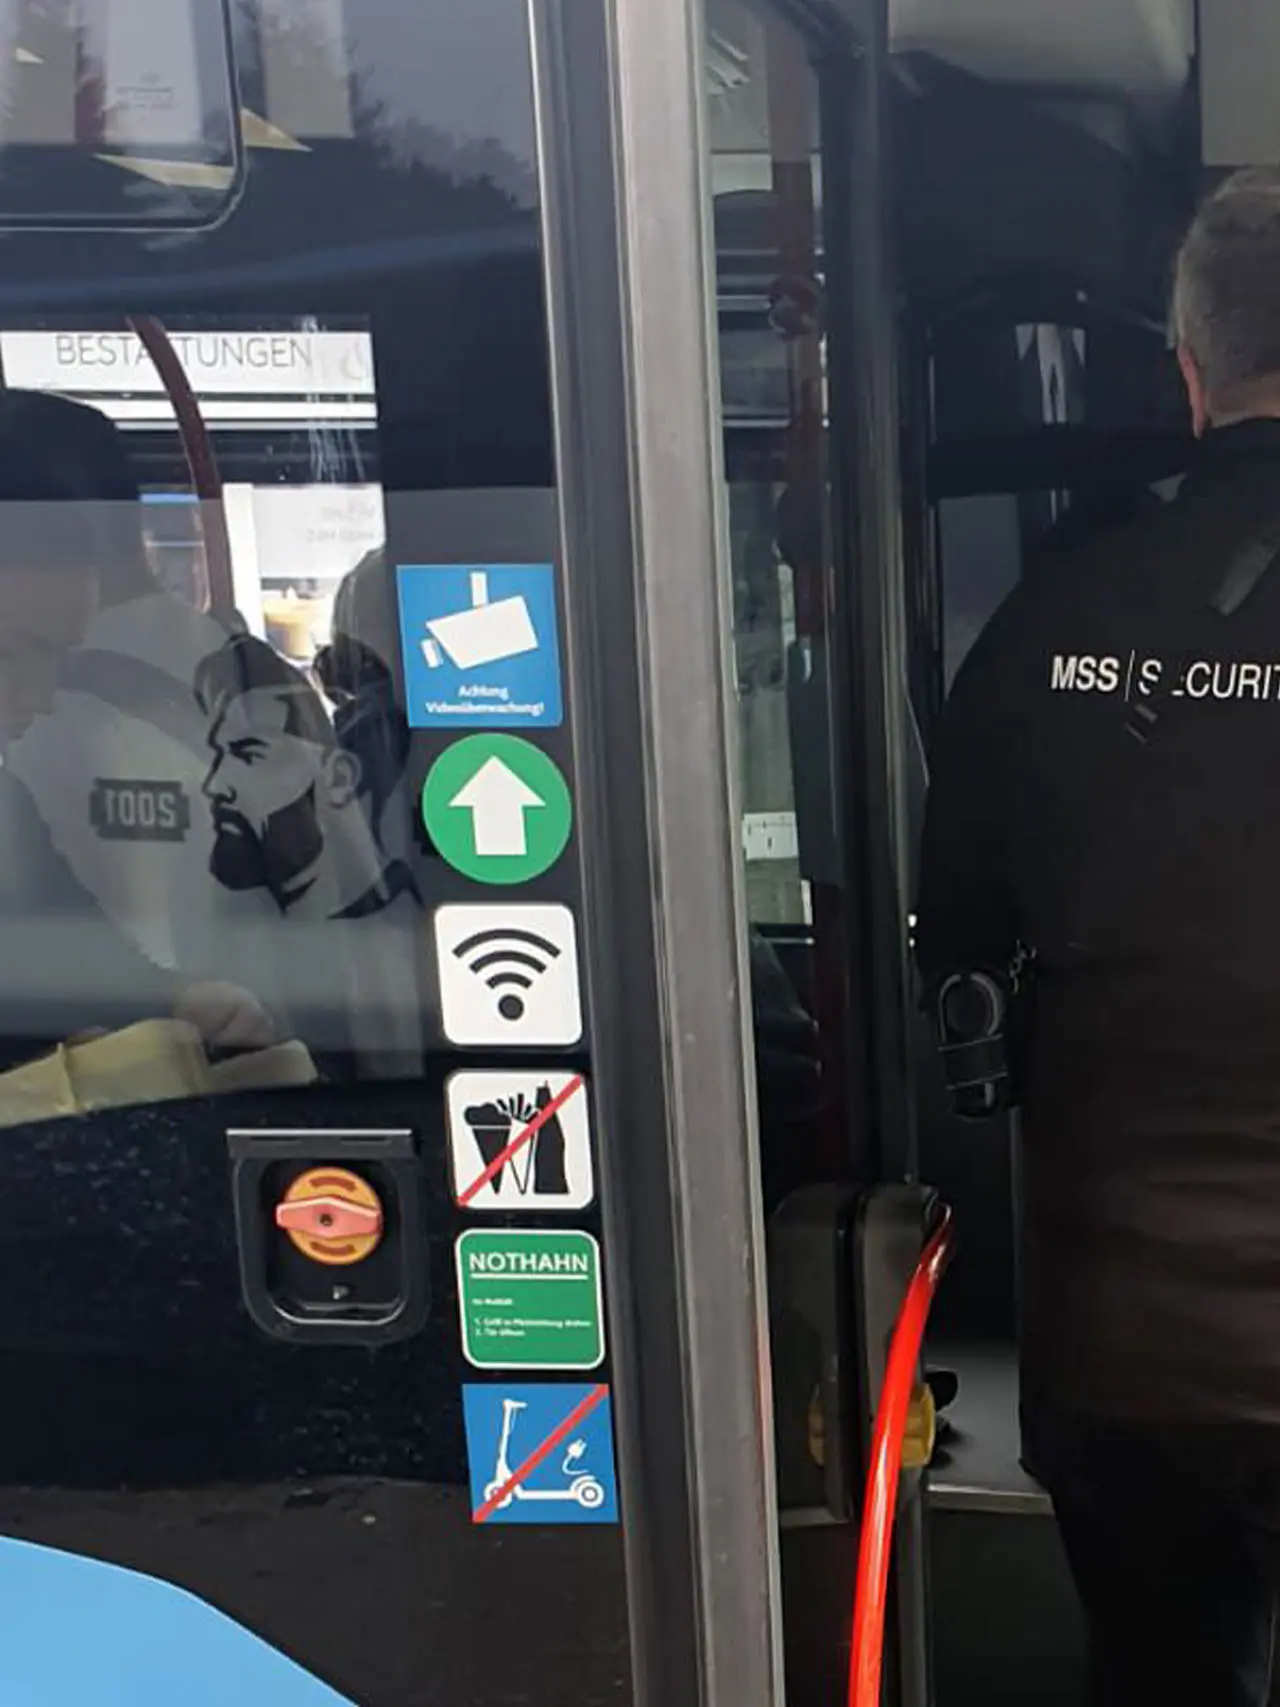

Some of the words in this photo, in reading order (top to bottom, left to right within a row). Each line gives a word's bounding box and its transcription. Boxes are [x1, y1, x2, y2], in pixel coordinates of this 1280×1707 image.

[56, 335, 312, 367] BESTATUNGEN
[1051, 655, 1120, 692] MSS
[469, 1252, 589, 1272] NOTHAHN
